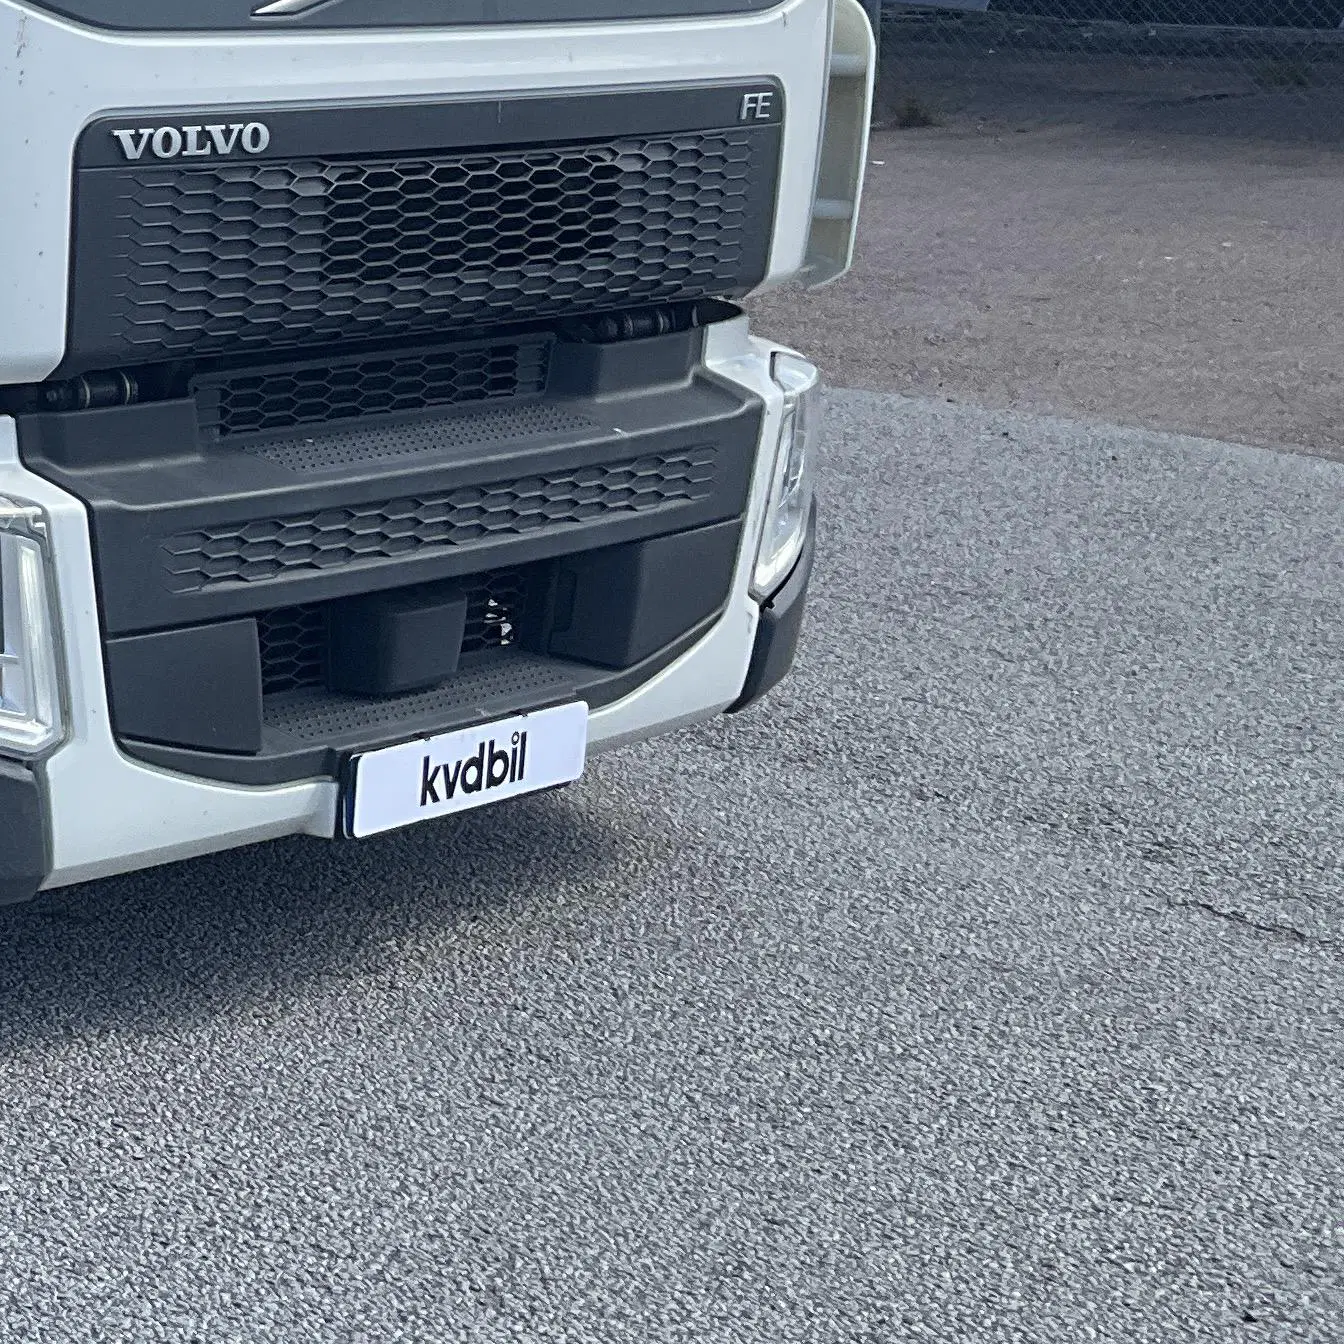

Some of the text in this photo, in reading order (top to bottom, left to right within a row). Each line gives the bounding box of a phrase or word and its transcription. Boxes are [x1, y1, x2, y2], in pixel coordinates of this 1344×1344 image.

[740, 92, 773, 120] FE
[112, 122, 270, 160] VOLVO
[420, 731, 527, 807] kvdbil
